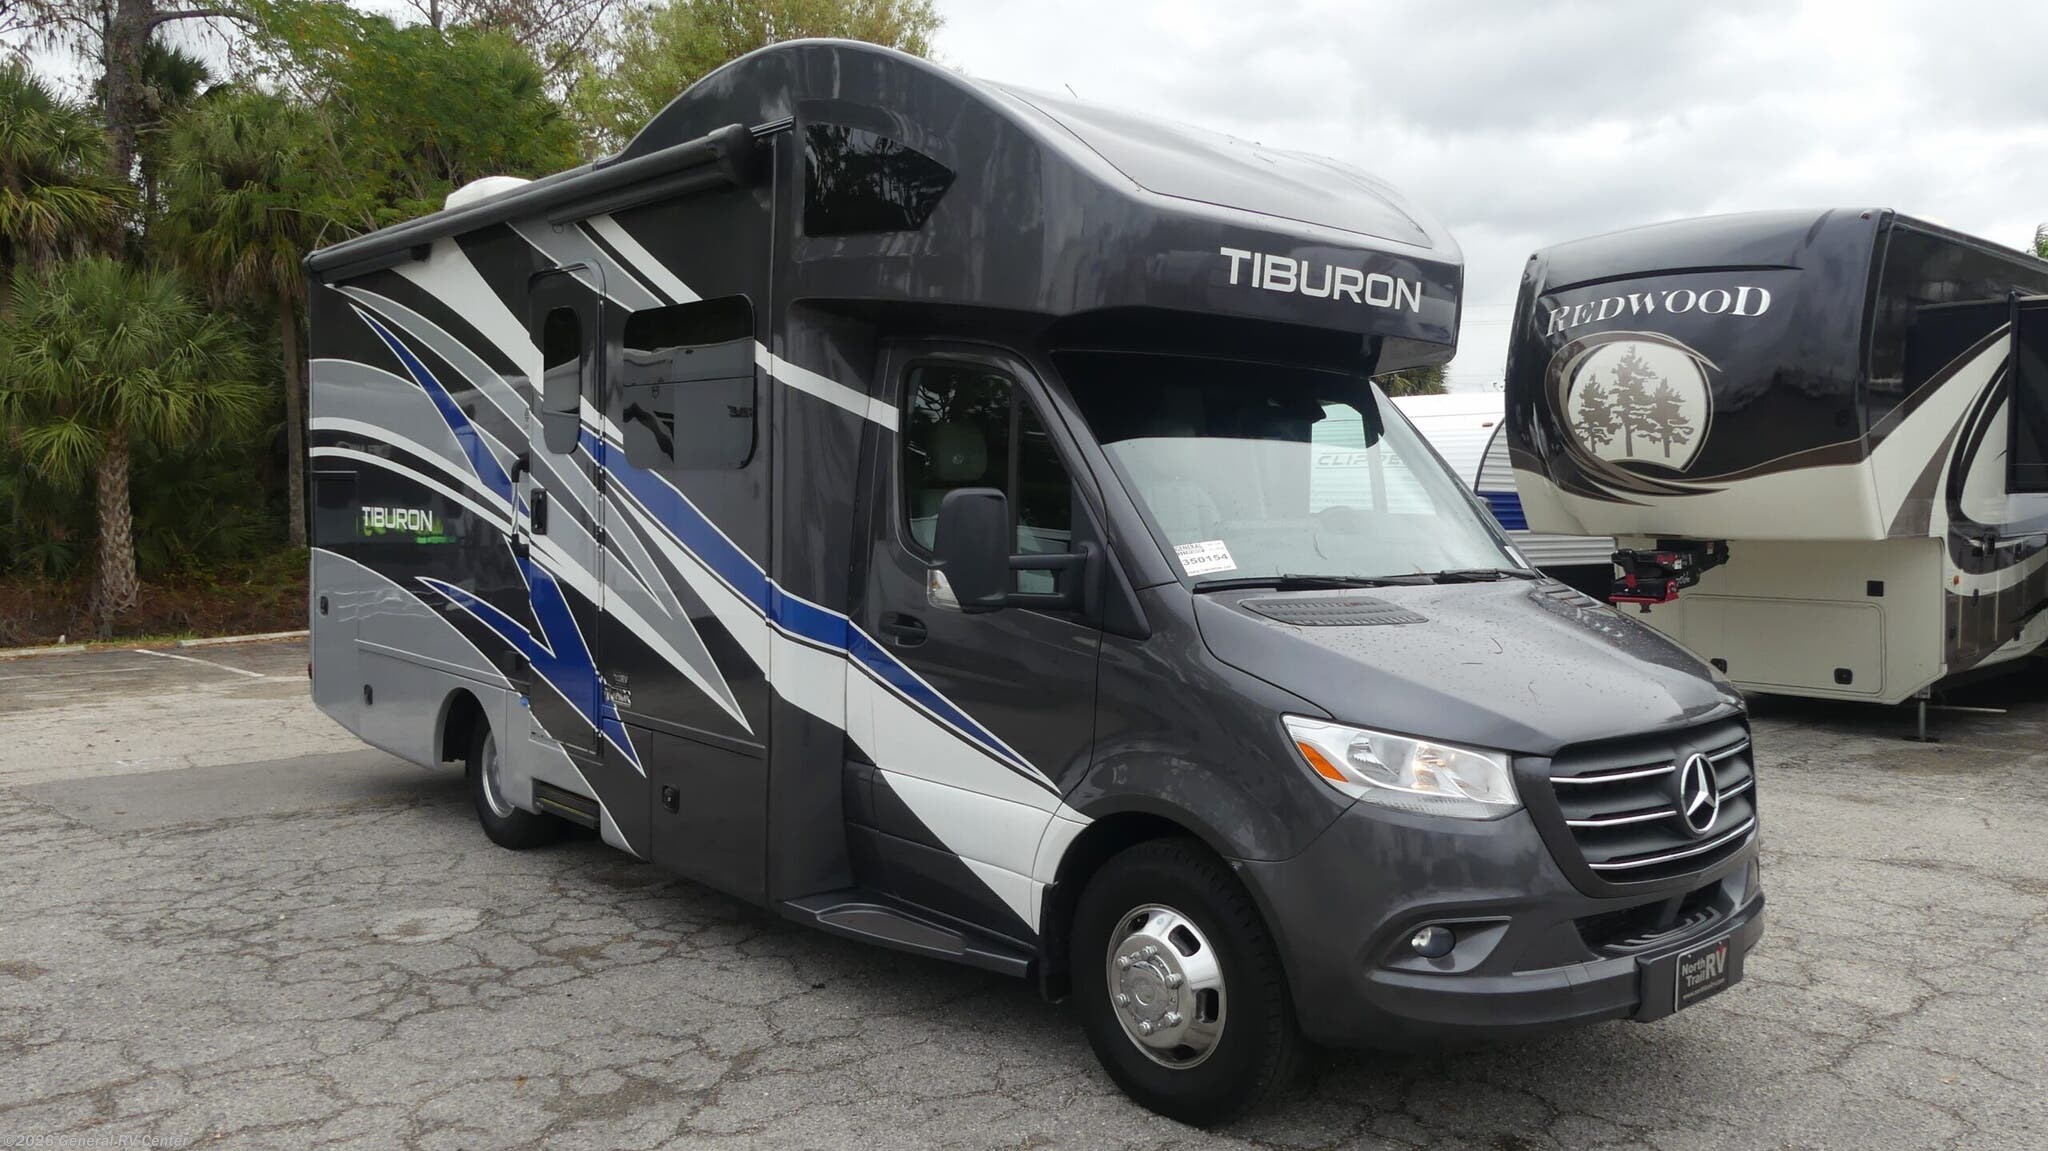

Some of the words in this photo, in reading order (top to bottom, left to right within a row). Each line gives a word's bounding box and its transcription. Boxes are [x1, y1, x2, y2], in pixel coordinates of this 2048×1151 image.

[1220, 247, 1422, 313] TIBURON
[1545, 286, 1771, 337] REDWOOD
[361, 506, 433, 532] TIBURON
[1182, 553, 1229, 566] 350154
[1682, 957, 1706, 977] North
[1706, 947, 1727, 980] RV
[1686, 970, 1706, 987] Trail
